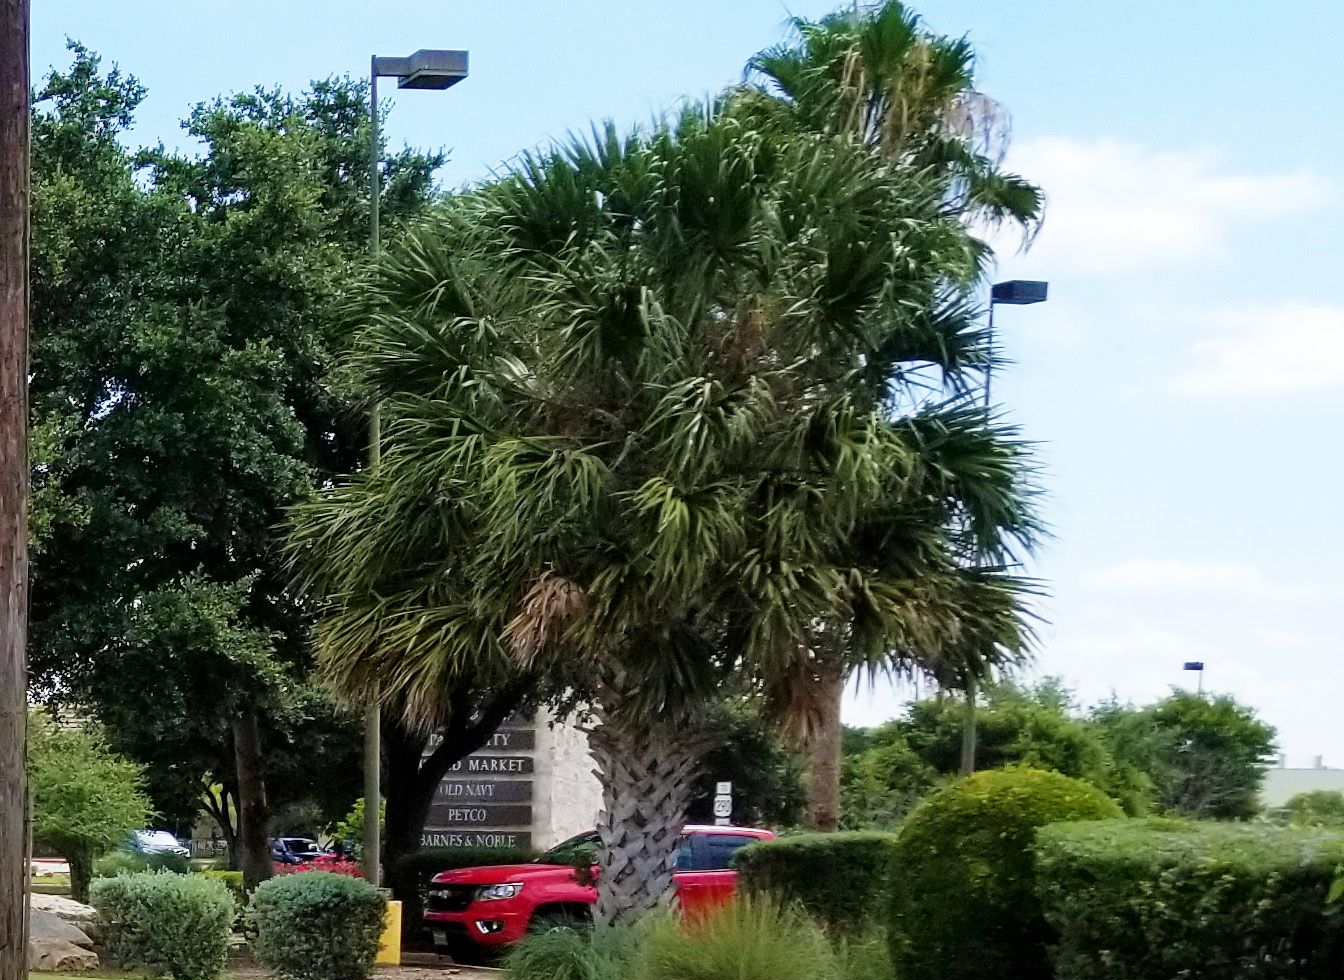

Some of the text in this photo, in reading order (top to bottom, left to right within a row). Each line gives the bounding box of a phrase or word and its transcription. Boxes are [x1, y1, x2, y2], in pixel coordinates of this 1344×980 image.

[468, 760, 524, 772] MARKET
[440, 784, 495, 796] OLD NAVY
[448, 808, 487, 821] PETCO
[464, 835, 472, 847] &
[476, 835, 516, 848] NOBLE
